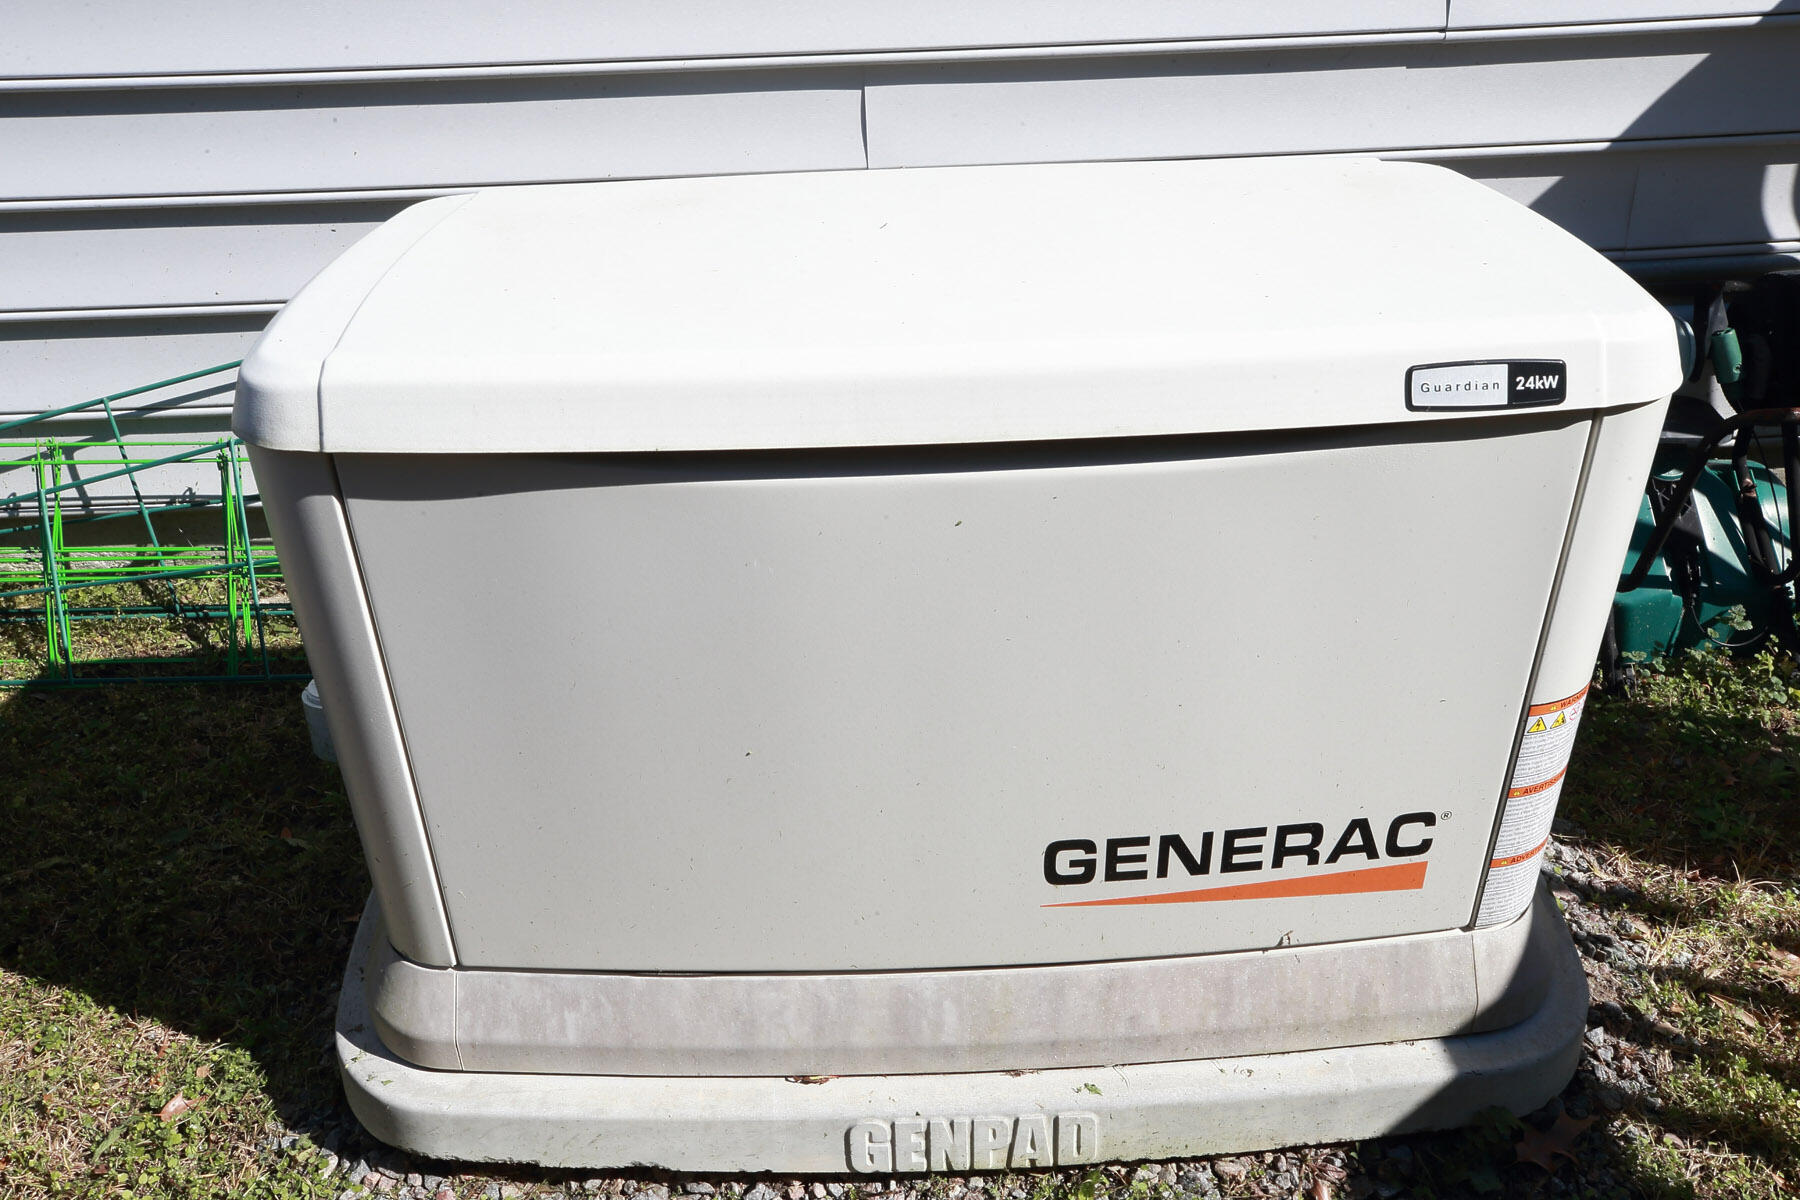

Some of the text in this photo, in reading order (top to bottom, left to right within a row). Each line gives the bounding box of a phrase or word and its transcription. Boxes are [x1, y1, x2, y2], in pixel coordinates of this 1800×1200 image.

[1420, 374, 1559, 393] Guardian 24kW
[1042, 810, 1437, 886] GENERAC
[843, 1110, 1099, 1174] GENPAD
